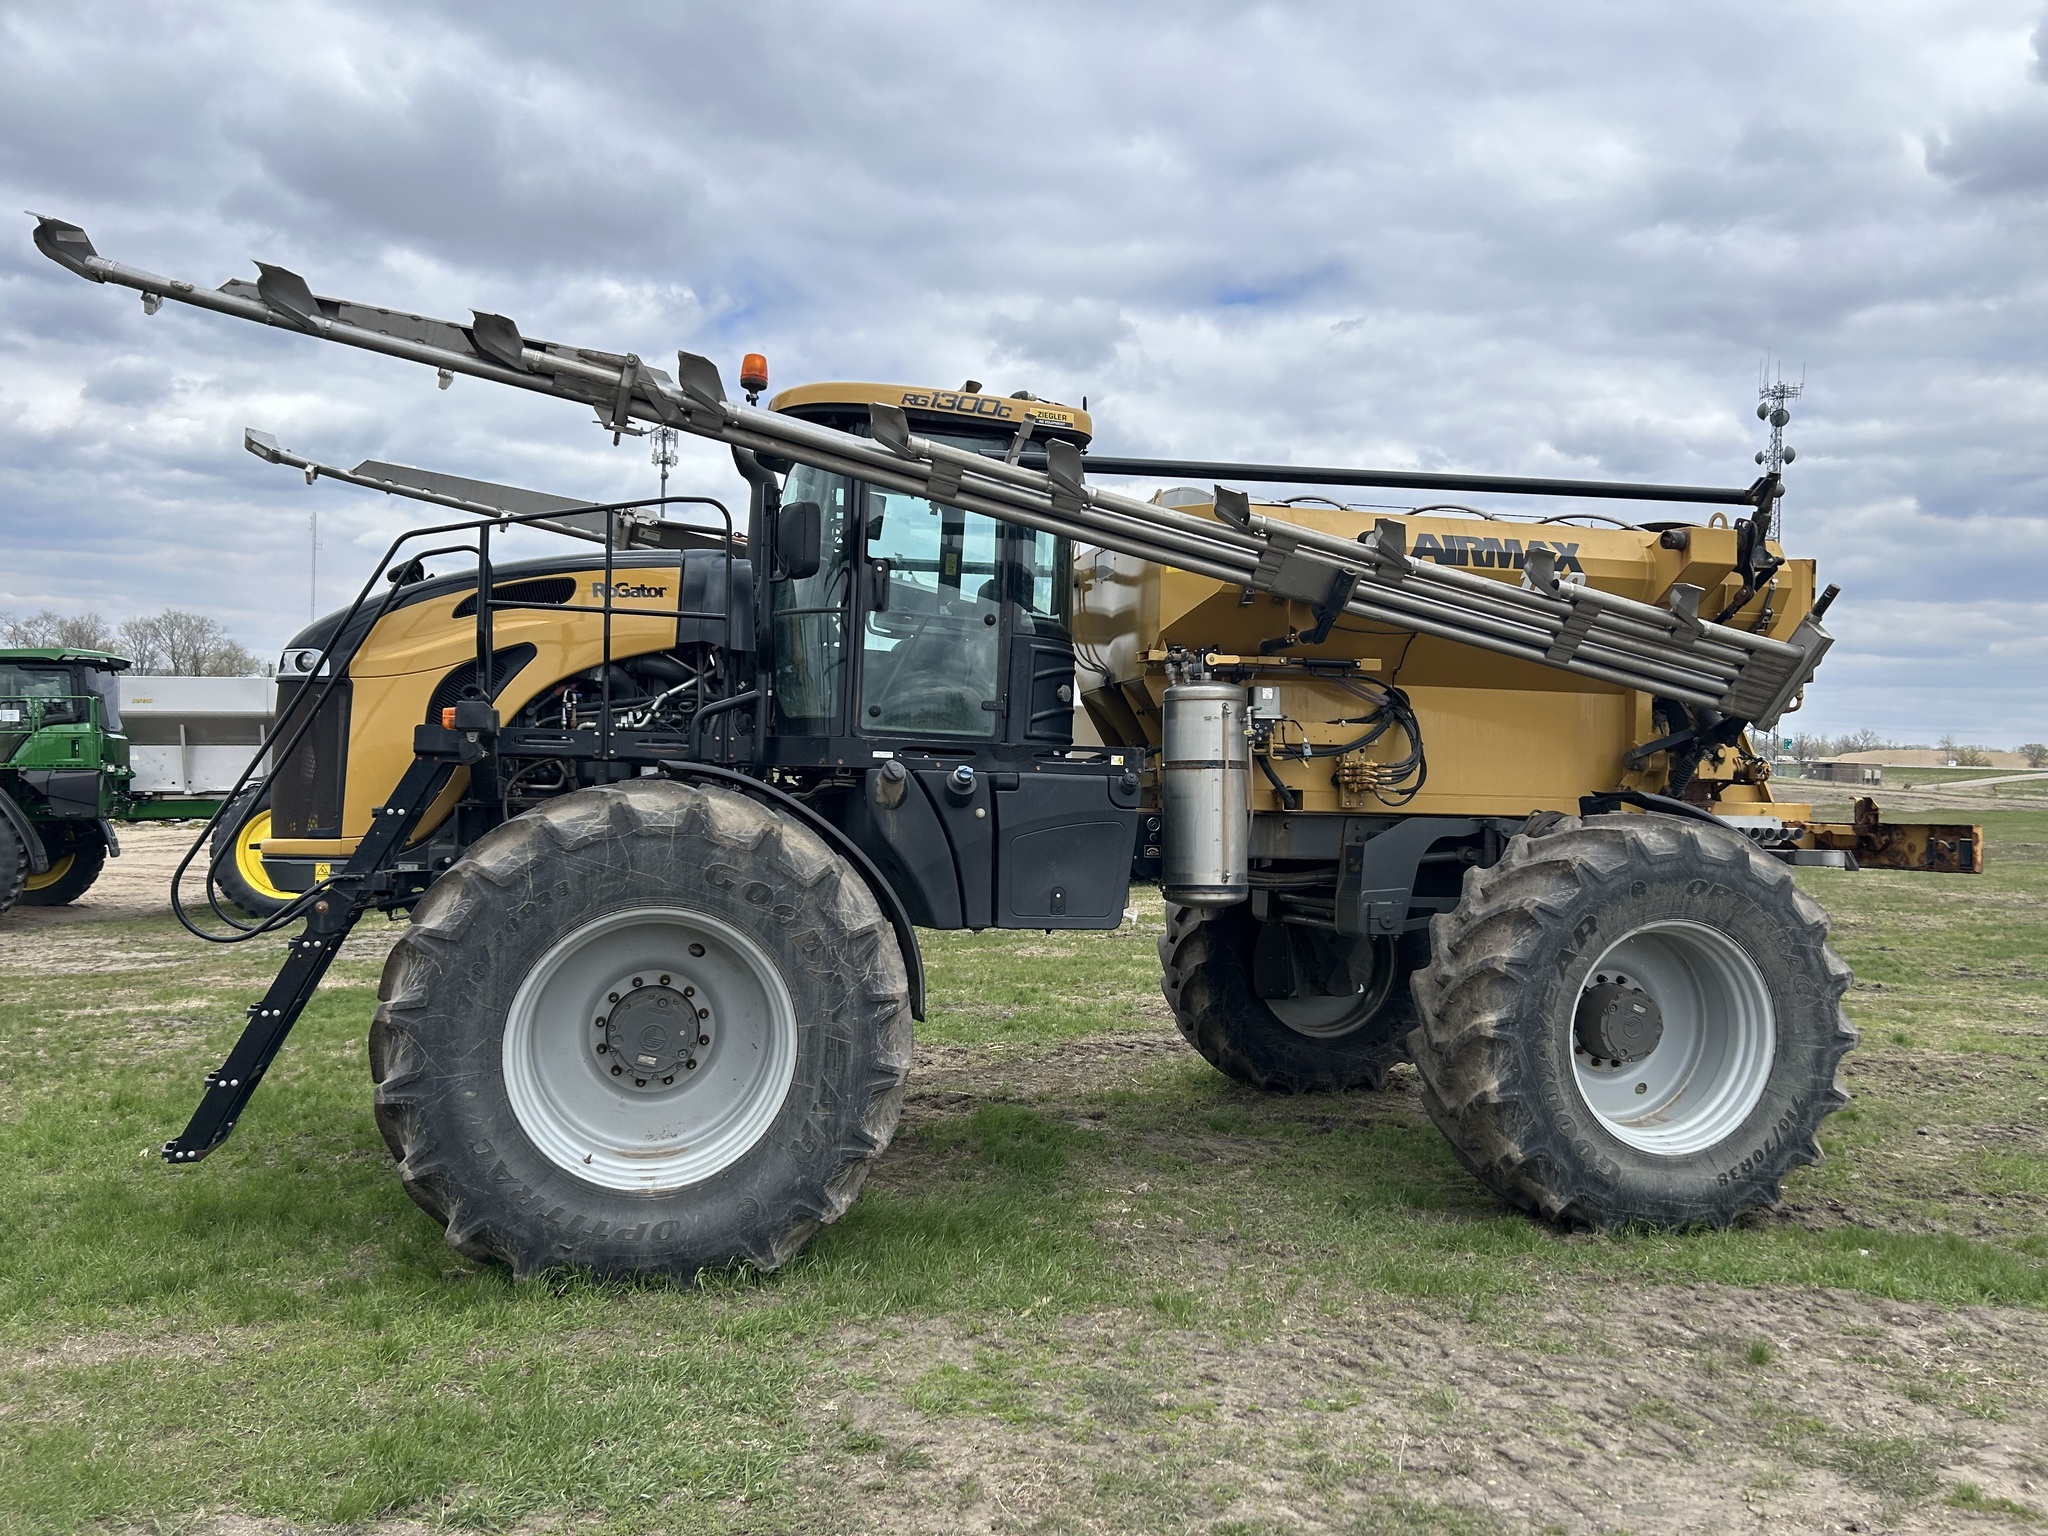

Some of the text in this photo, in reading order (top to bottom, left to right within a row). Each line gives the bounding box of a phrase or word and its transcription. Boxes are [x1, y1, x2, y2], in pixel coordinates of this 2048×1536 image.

[1037, 411, 1068, 421] ZIEGLER
[1685, 878, 1812, 996] OPTITRAC
[468, 1137, 682, 1245] OPTITRAC
[1716, 1094, 1805, 1188] 710/70R38
